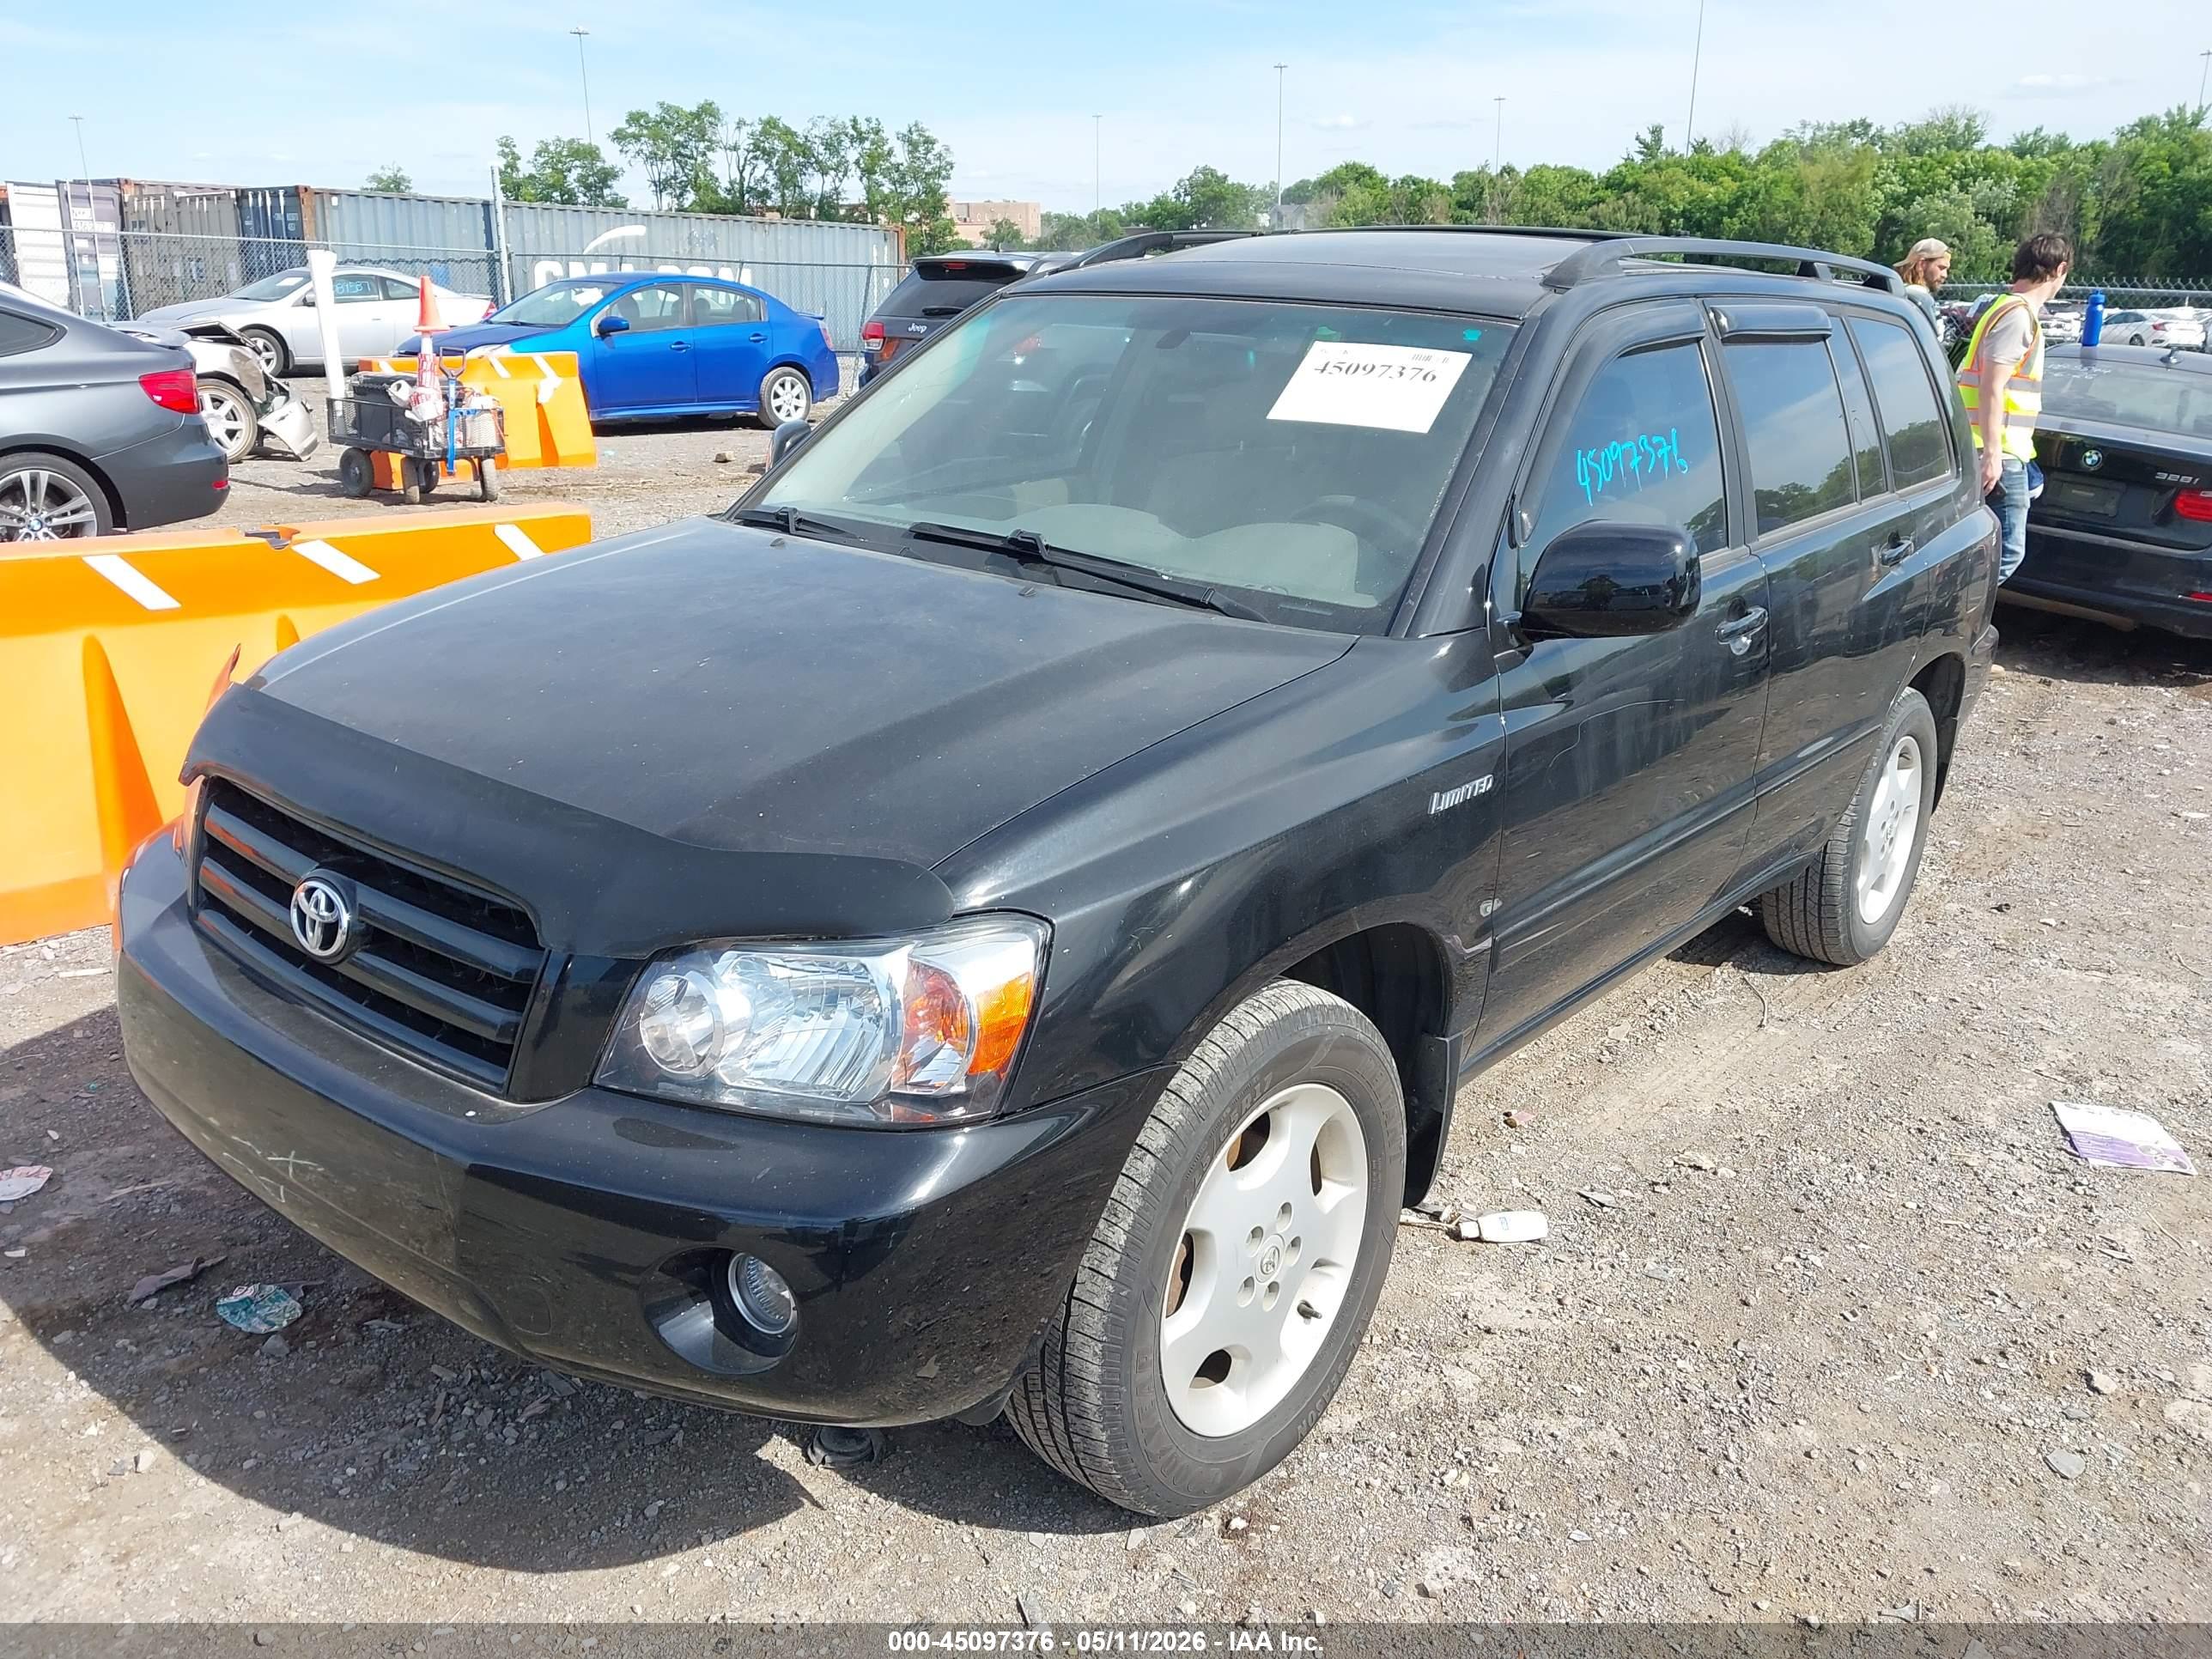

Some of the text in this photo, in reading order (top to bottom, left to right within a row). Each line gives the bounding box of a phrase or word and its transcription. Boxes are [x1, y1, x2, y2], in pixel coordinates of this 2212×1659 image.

[908, 323, 927, 334] Jeep
[1314, 360, 1437, 383] 45097376
[1575, 427, 1689, 507] 45097376
[1427, 774, 1494, 815] LIMITED
